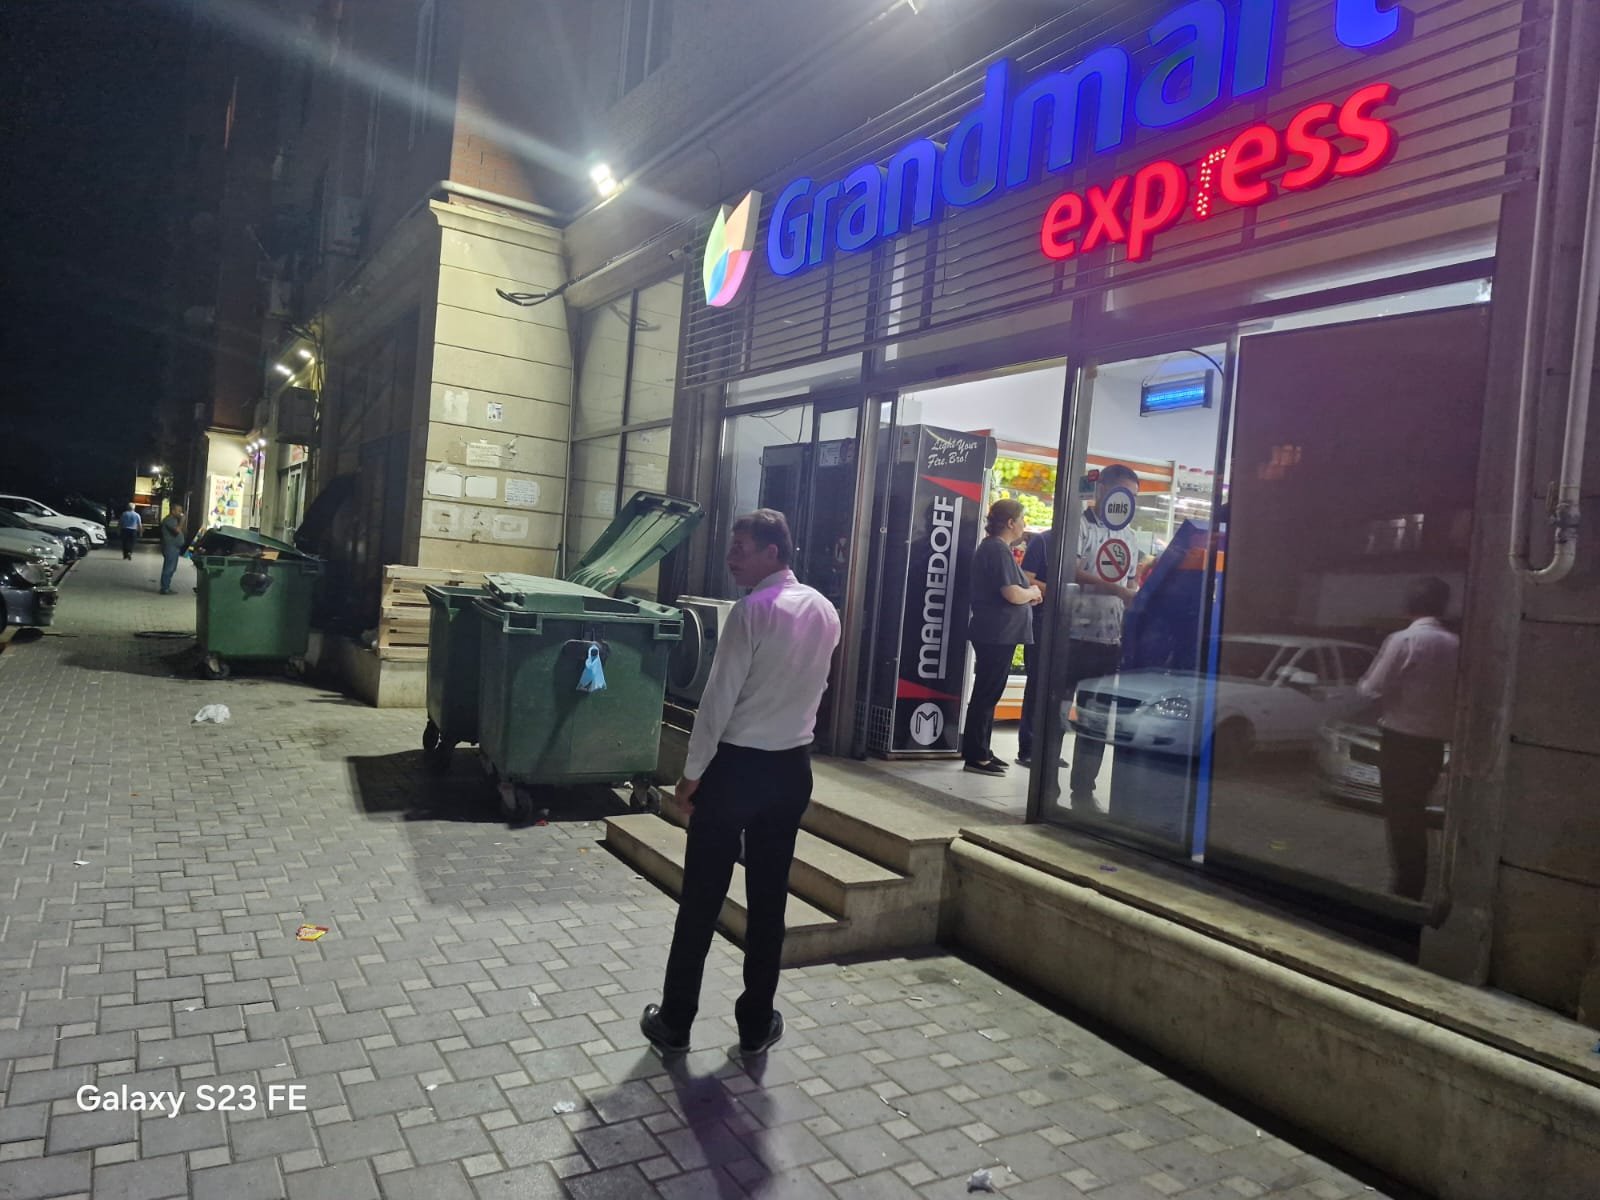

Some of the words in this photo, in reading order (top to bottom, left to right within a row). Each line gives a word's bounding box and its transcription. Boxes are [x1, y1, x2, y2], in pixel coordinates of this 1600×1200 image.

[766, 0, 1402, 276] Grandma
[1040, 82, 1398, 262] express
[957, 439, 977, 455] Your
[917, 495, 955, 680] MAMEDOFF
